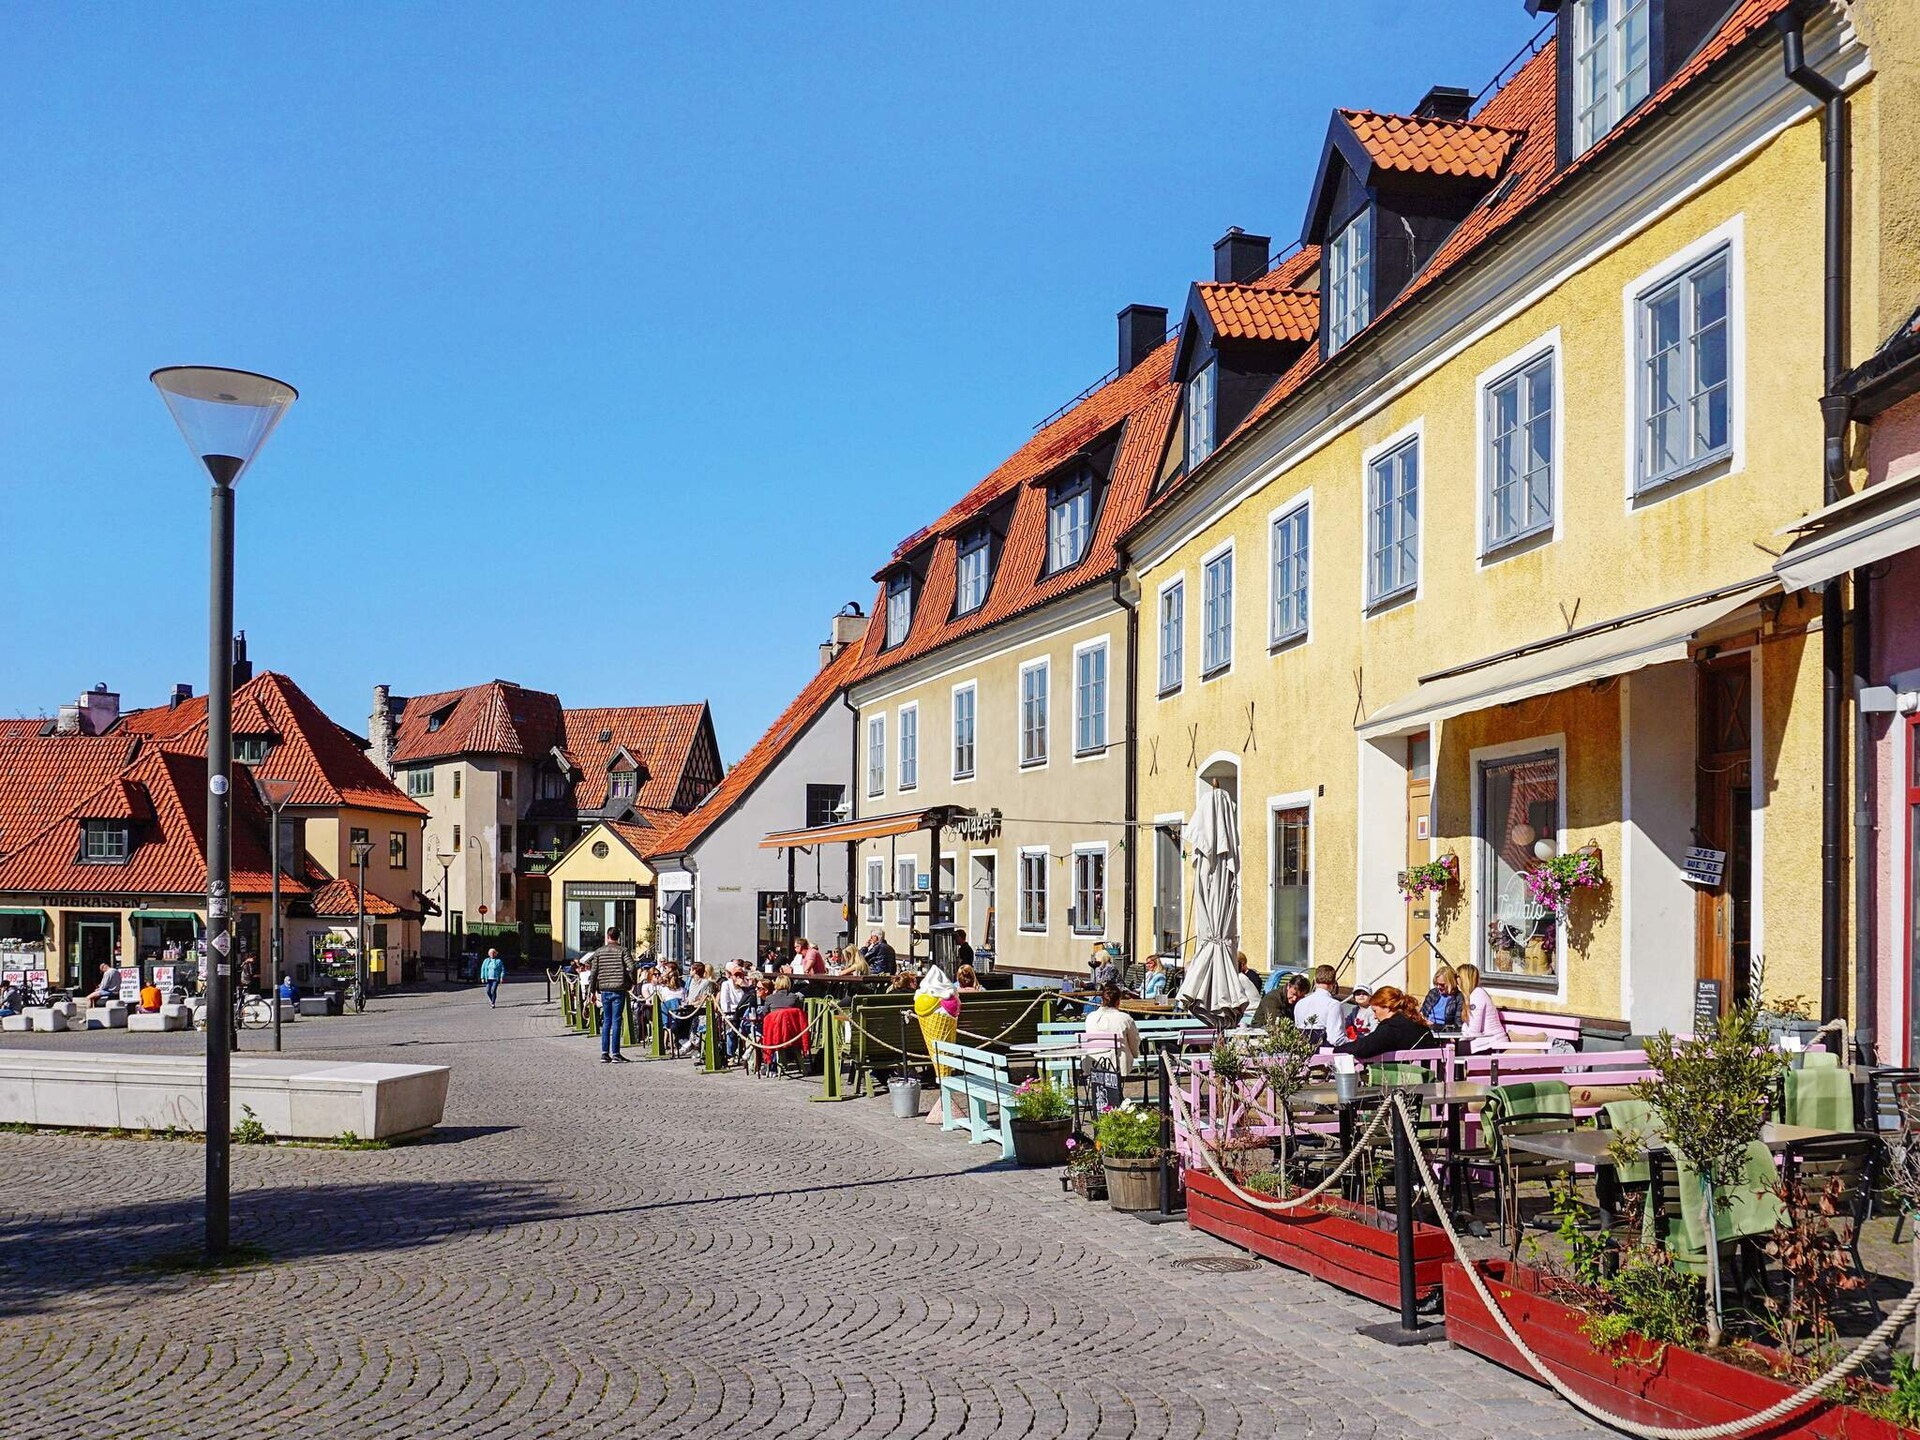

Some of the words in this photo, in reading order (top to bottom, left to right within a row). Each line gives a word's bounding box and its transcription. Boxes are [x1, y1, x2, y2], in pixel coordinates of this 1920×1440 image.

[1694, 849, 1716, 859] YES
[1687, 860, 1719, 872] WE'RE
[1687, 872, 1716, 883] OPEN
[39, 895, 141, 908] TORGKASSEN
